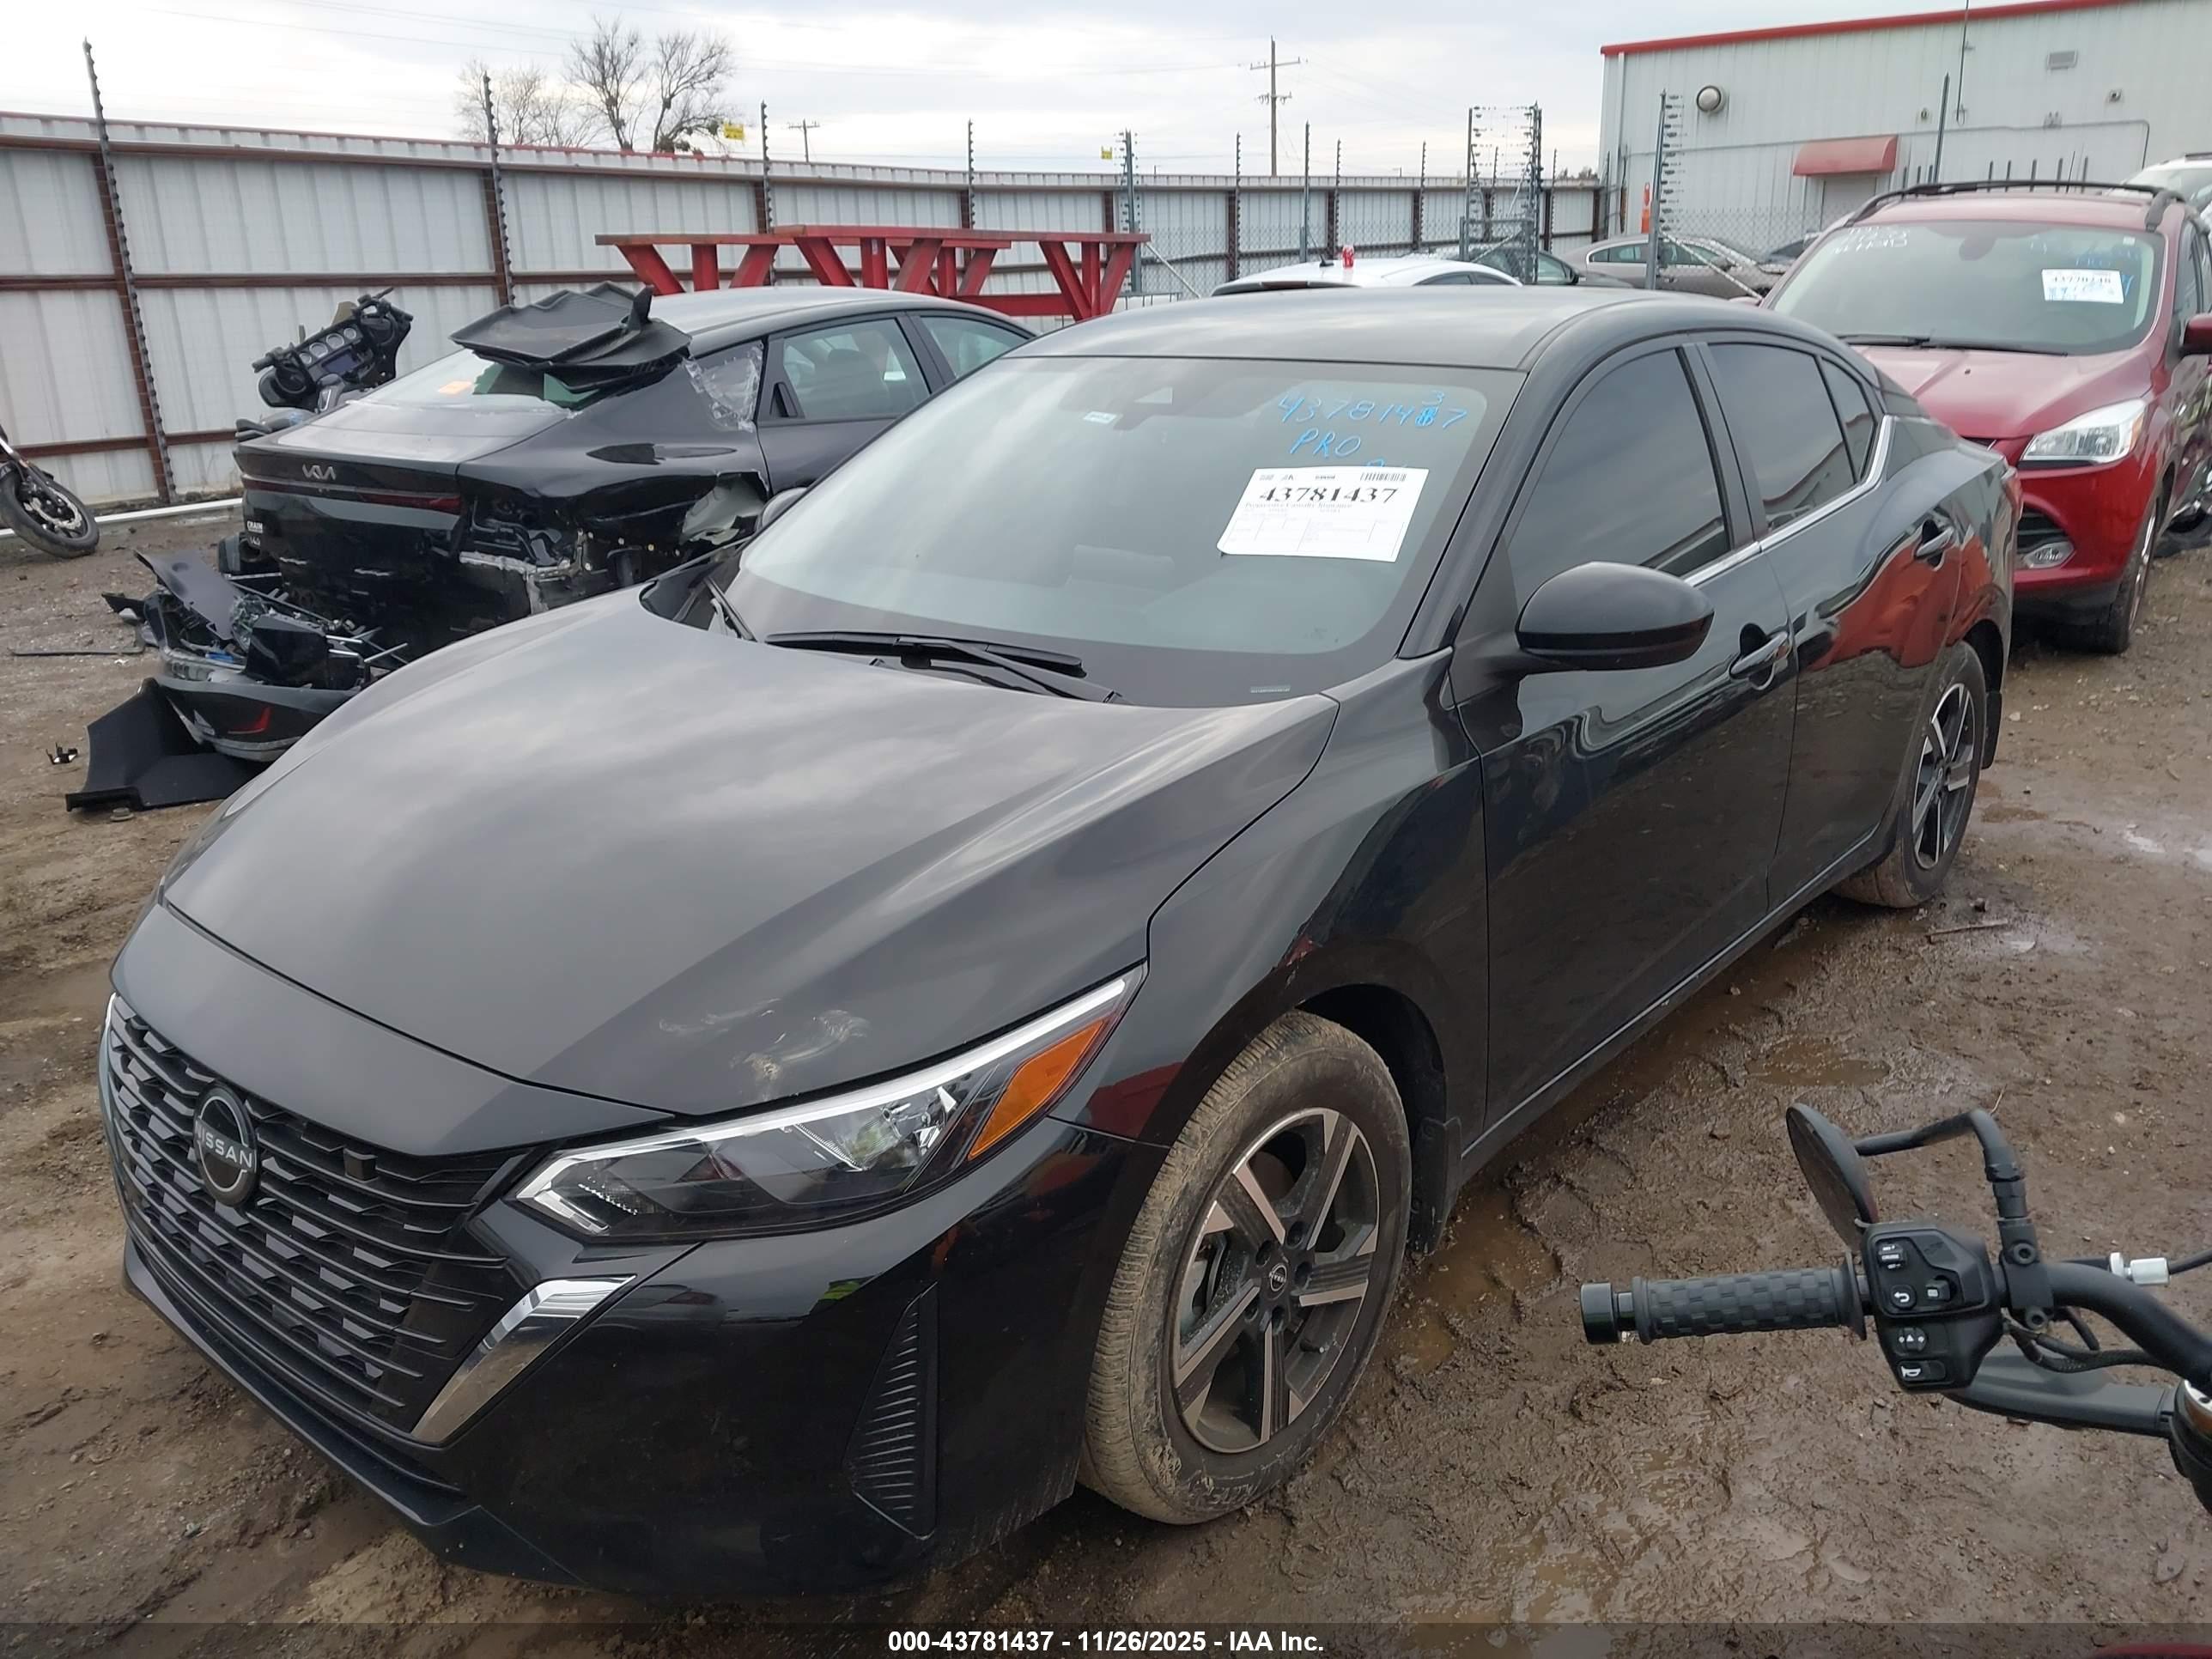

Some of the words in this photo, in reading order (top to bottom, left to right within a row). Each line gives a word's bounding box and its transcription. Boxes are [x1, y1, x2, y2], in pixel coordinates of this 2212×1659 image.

[1290, 428, 1362, 457] PRO
[1260, 487, 1399, 503] 43781437
[195, 1121, 252, 1169] NISSAN
